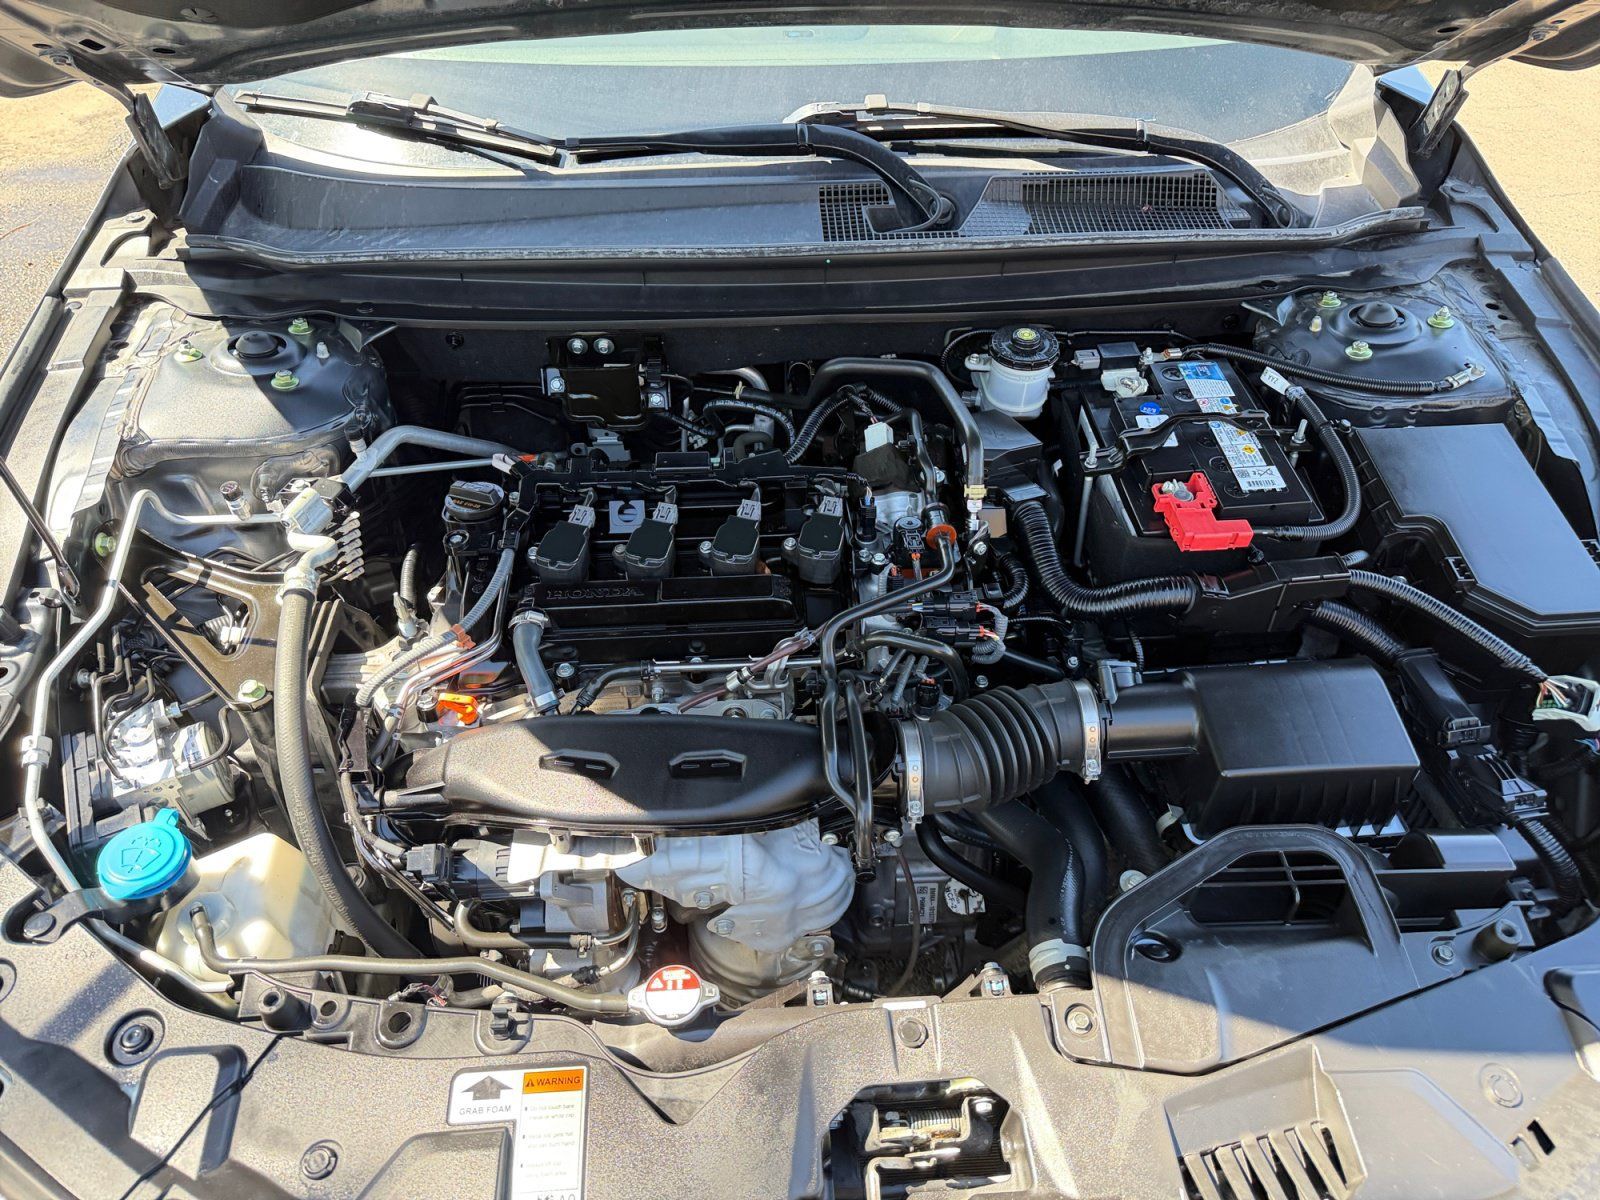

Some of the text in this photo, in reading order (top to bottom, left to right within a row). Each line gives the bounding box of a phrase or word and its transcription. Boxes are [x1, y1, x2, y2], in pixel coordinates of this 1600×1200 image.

[545, 587, 645, 600] HONDA
[536, 1076, 581, 1086] WARNING
[459, 1105, 512, 1116] GRAB FOAM
